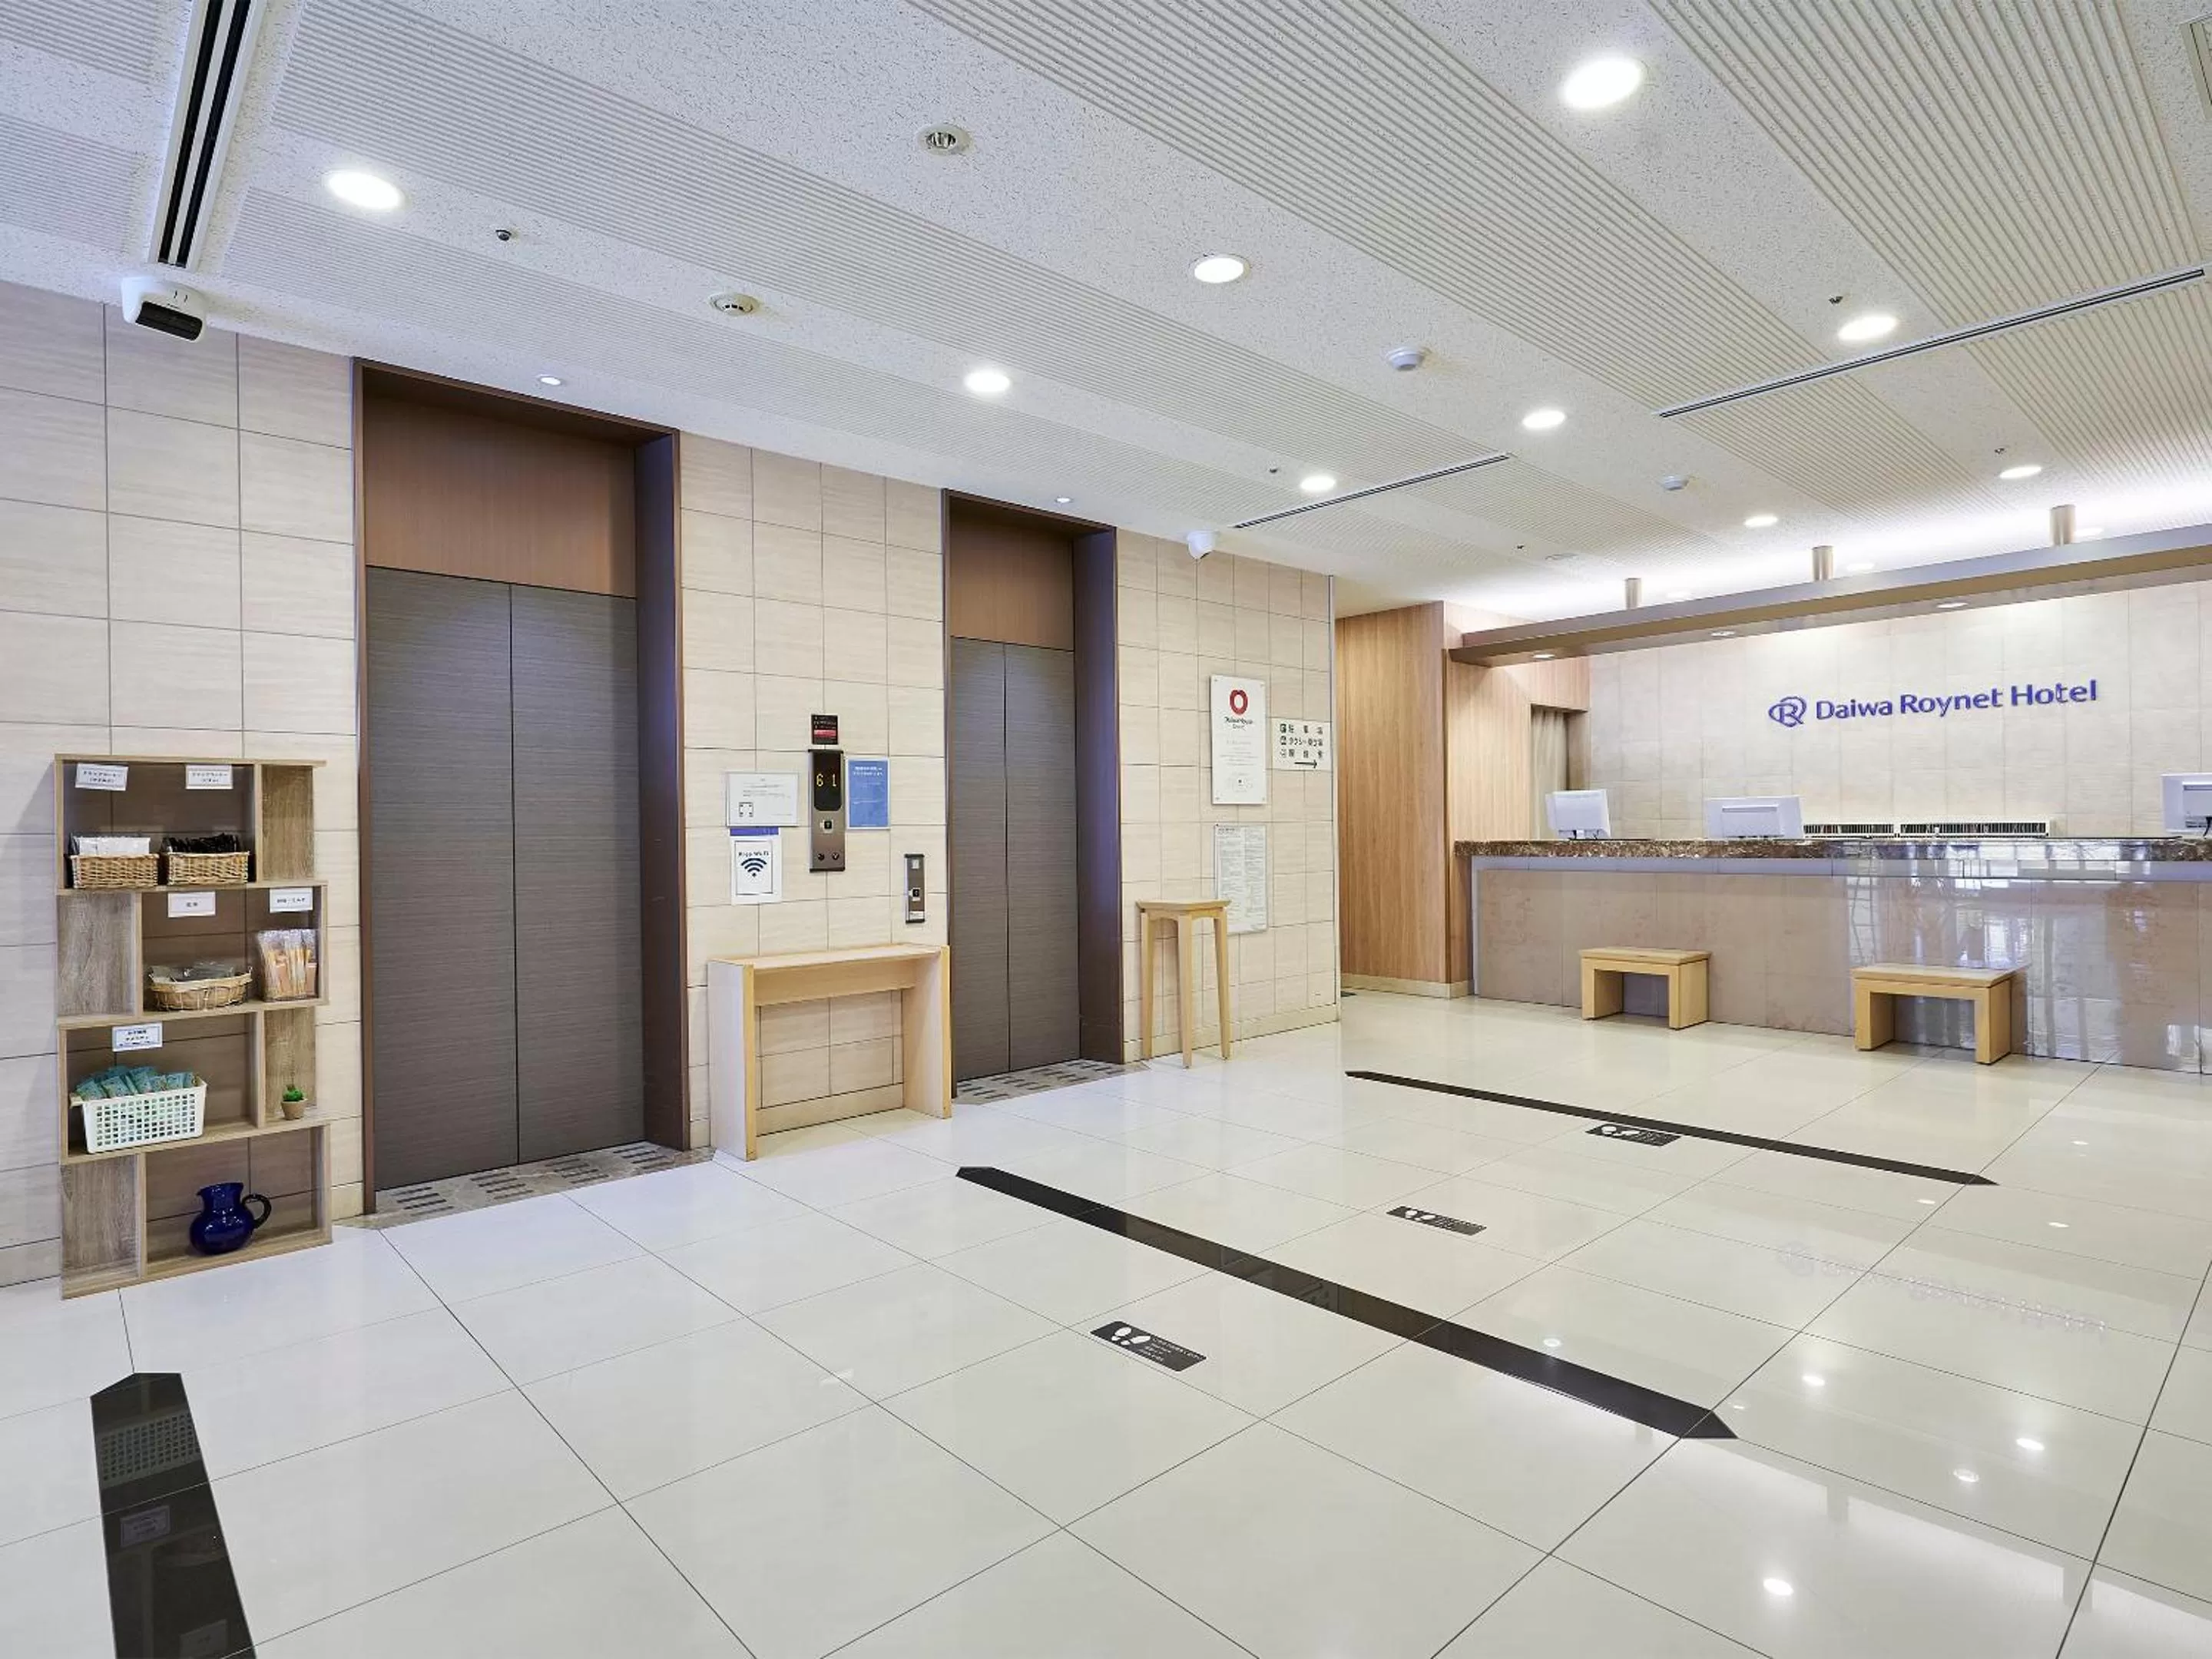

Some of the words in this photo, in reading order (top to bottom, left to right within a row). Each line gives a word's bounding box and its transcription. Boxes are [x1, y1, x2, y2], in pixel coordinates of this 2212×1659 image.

[1816, 699, 1893, 720] Daiwa
[1900, 688, 2003, 717] Roynet
[2011, 679, 2097, 706] Hotel
[816, 773, 823, 786] 6
[832, 773, 836, 786] 1
